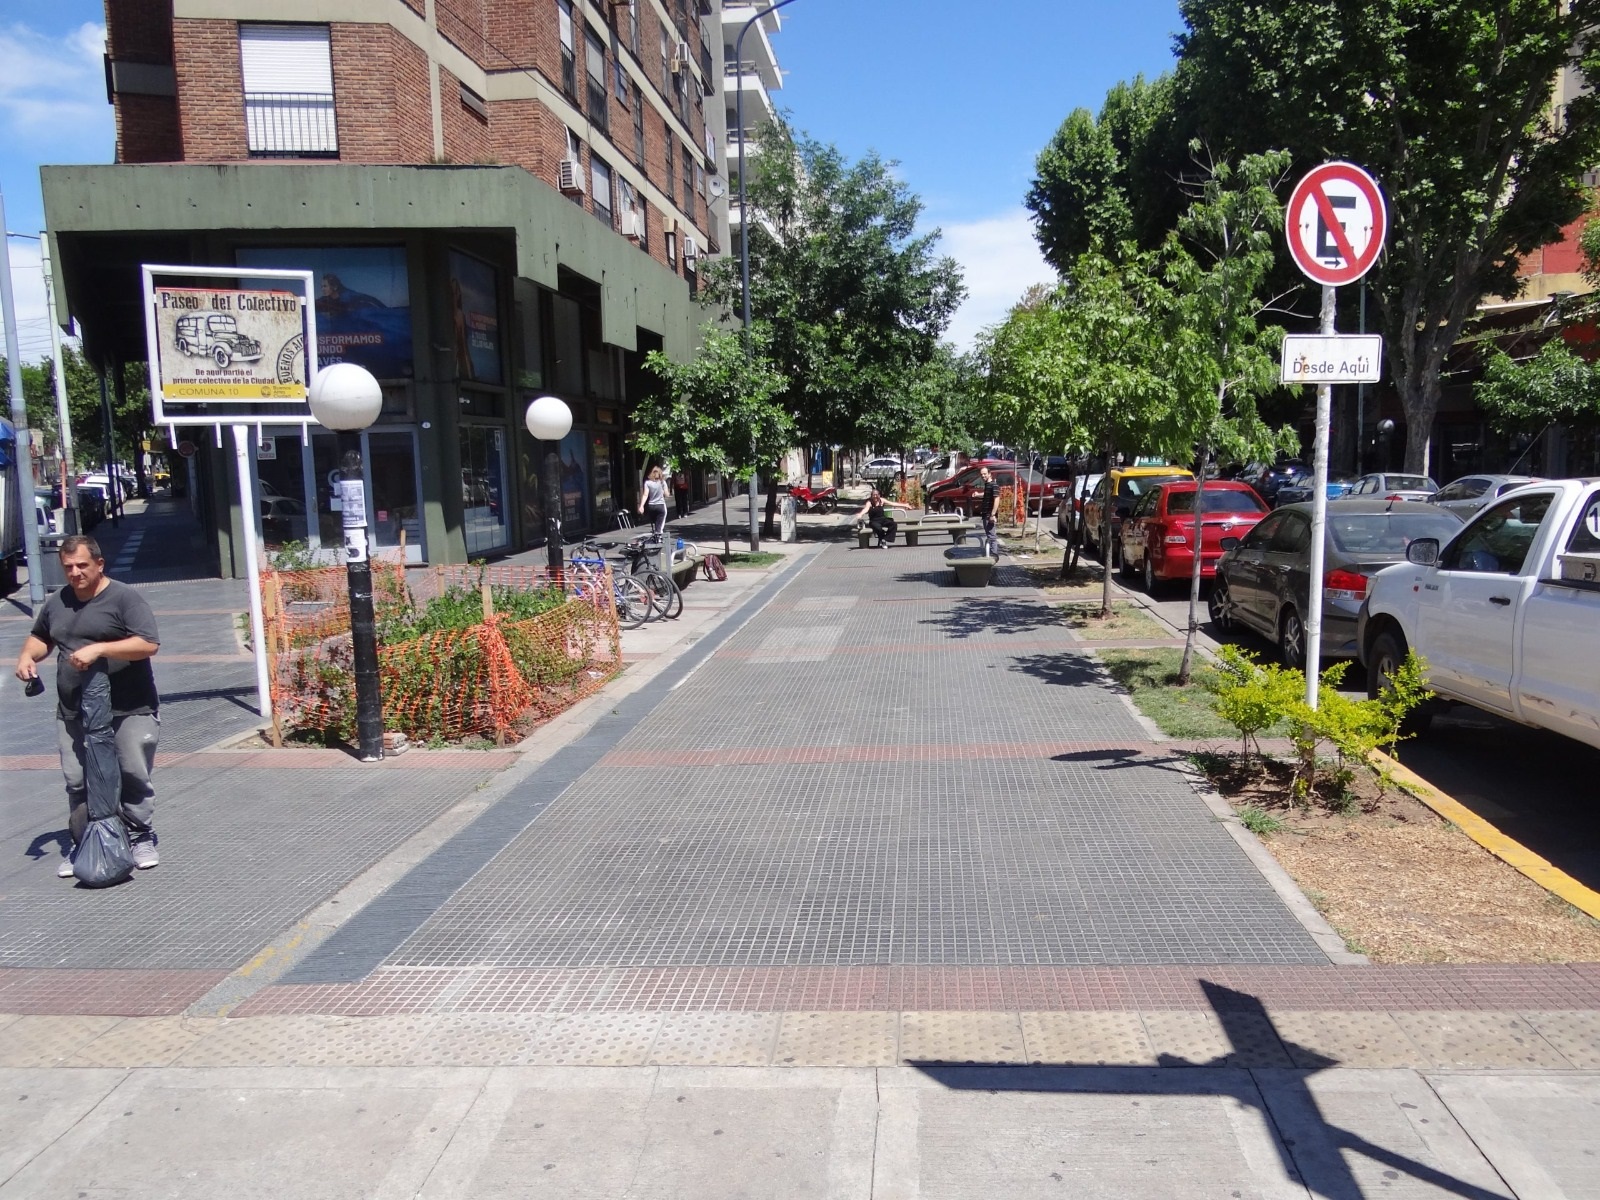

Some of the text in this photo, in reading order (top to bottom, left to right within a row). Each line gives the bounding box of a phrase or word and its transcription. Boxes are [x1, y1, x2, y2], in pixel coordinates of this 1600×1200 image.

[161, 292, 297, 312] Paseo del Colectivo
[316, 335, 382, 345] SFORMAMOS
[280, 347, 294, 384] BUENOS
[1293, 361, 1334, 374] Desde
[195, 368, 205, 376] De
[246, 368, 253, 376] el
[172, 377, 198, 385] primer
[198, 377, 231, 385] colectivo
[250, 377, 275, 385] Ciudad
[178, 388, 239, 396] COMUNA 10
